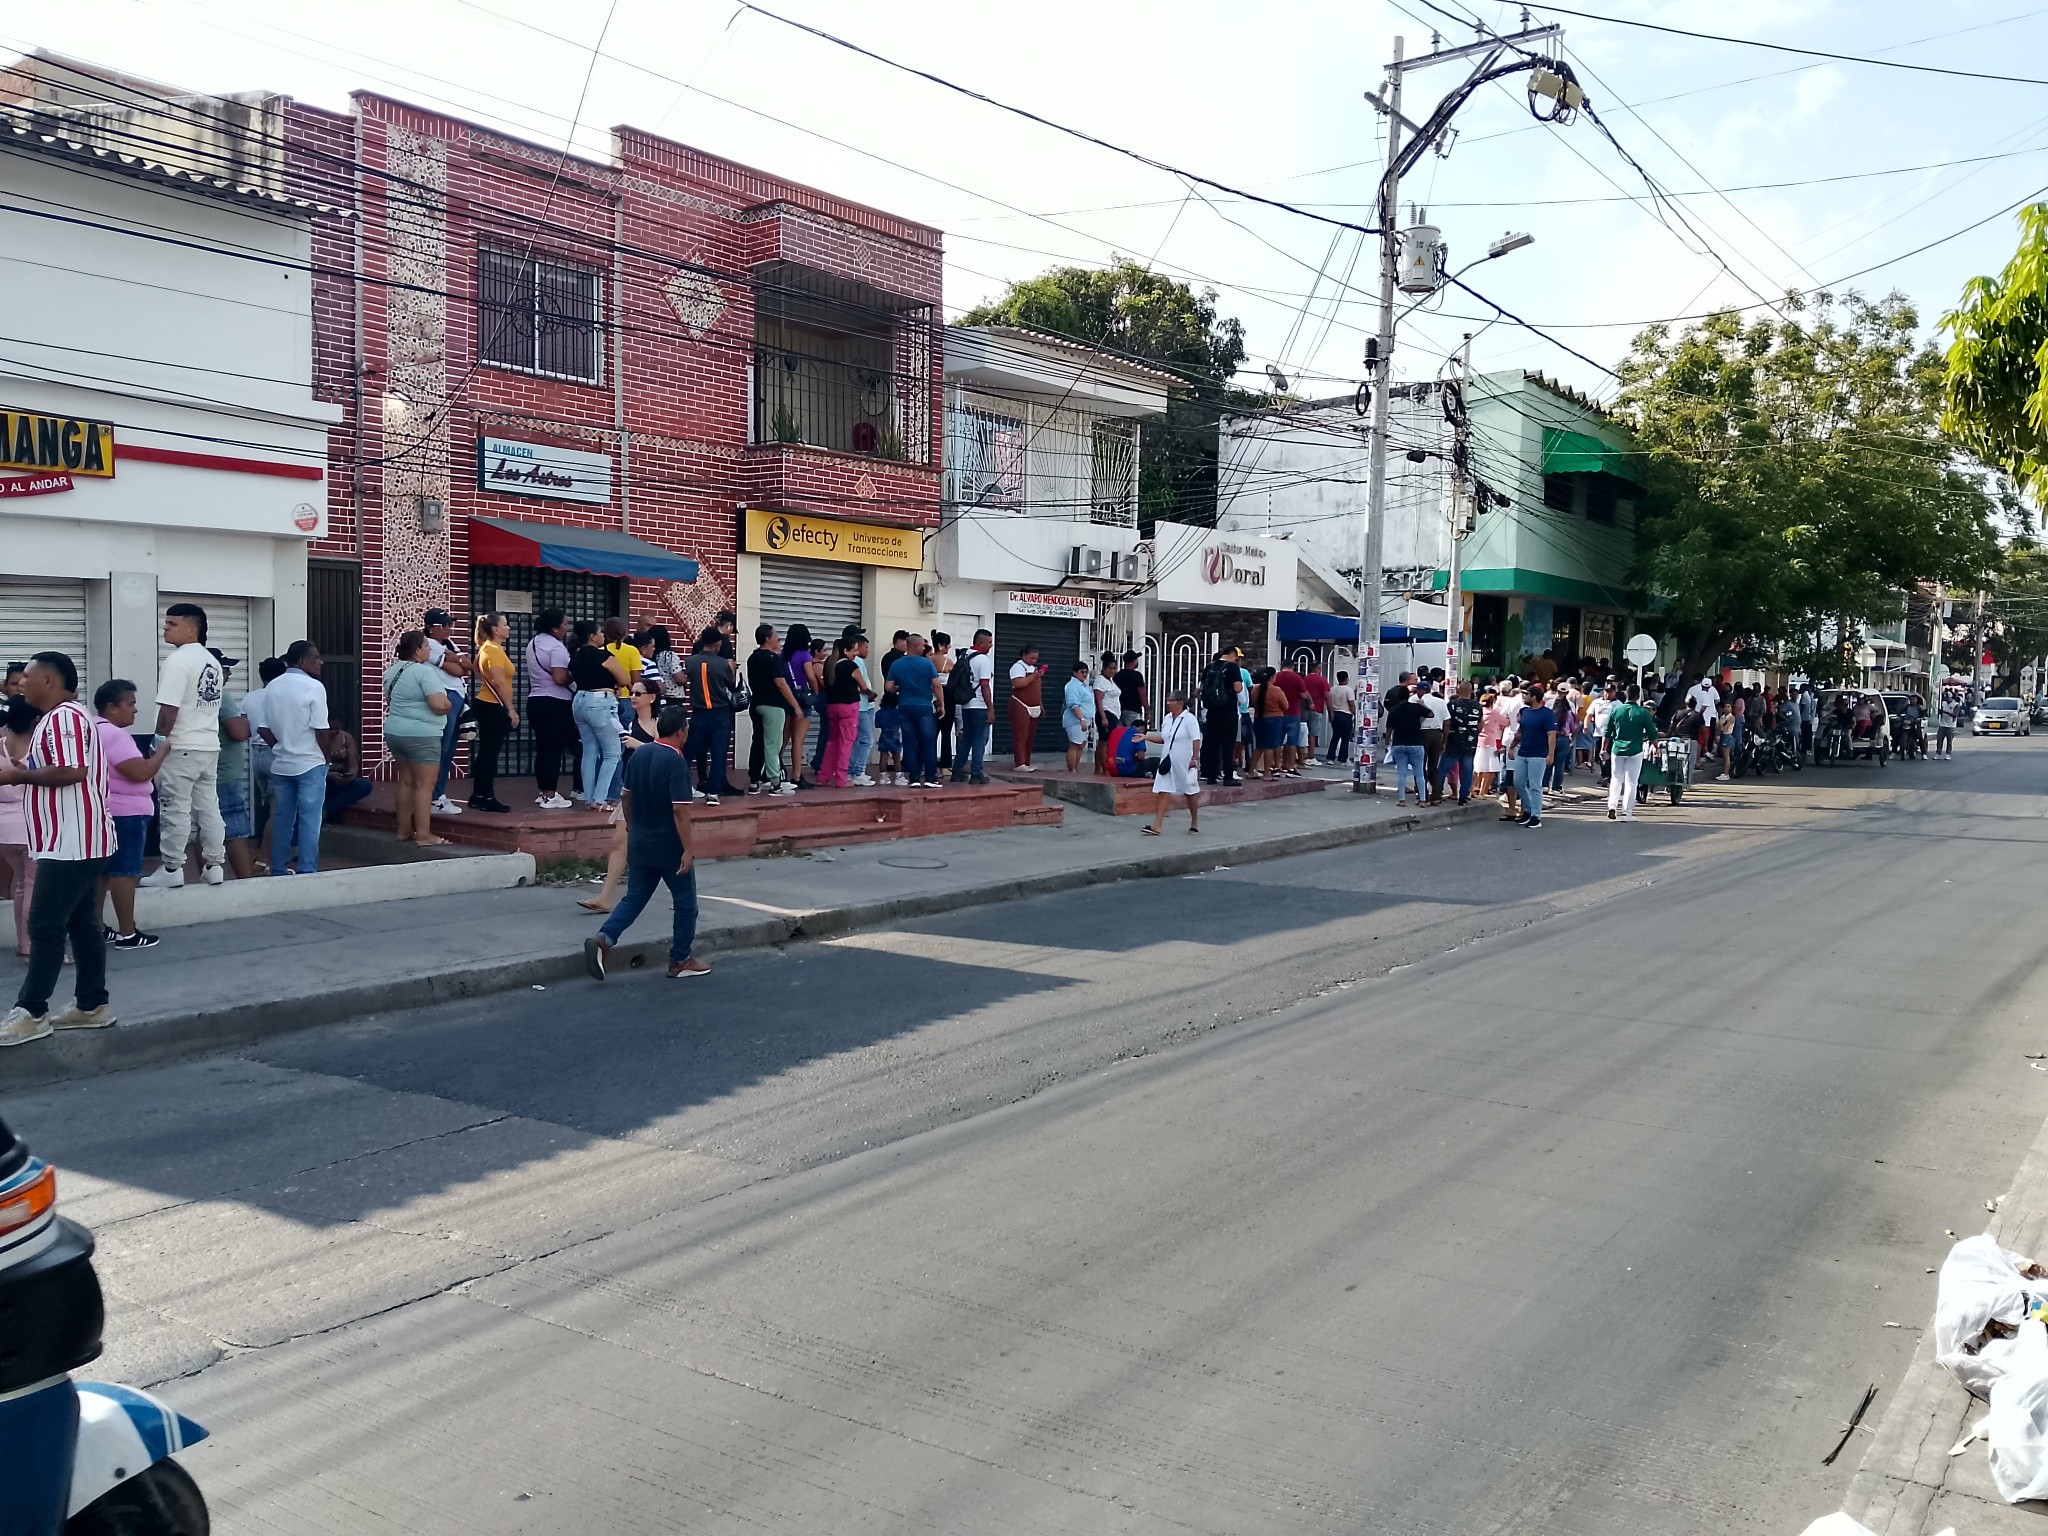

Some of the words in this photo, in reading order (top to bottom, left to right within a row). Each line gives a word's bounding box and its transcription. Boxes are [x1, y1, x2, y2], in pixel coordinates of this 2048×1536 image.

[492, 443, 534, 459] ALMACEN
[11, 482, 26, 492] AL
[29, 476, 69, 491] ANDAR
[792, 523, 839, 552] efecty
[853, 531, 890, 545] Universo
[891, 536, 902, 547] de
[847, 543, 908, 559] Transacciones
[1220, 553, 1266, 586] Doral
[1009, 591, 1019, 602] Dr.
[1019, 592, 1043, 604] ALVARO
[1043, 595, 1070, 606] MENDOZA
[1070, 597, 1094, 609] REALES
